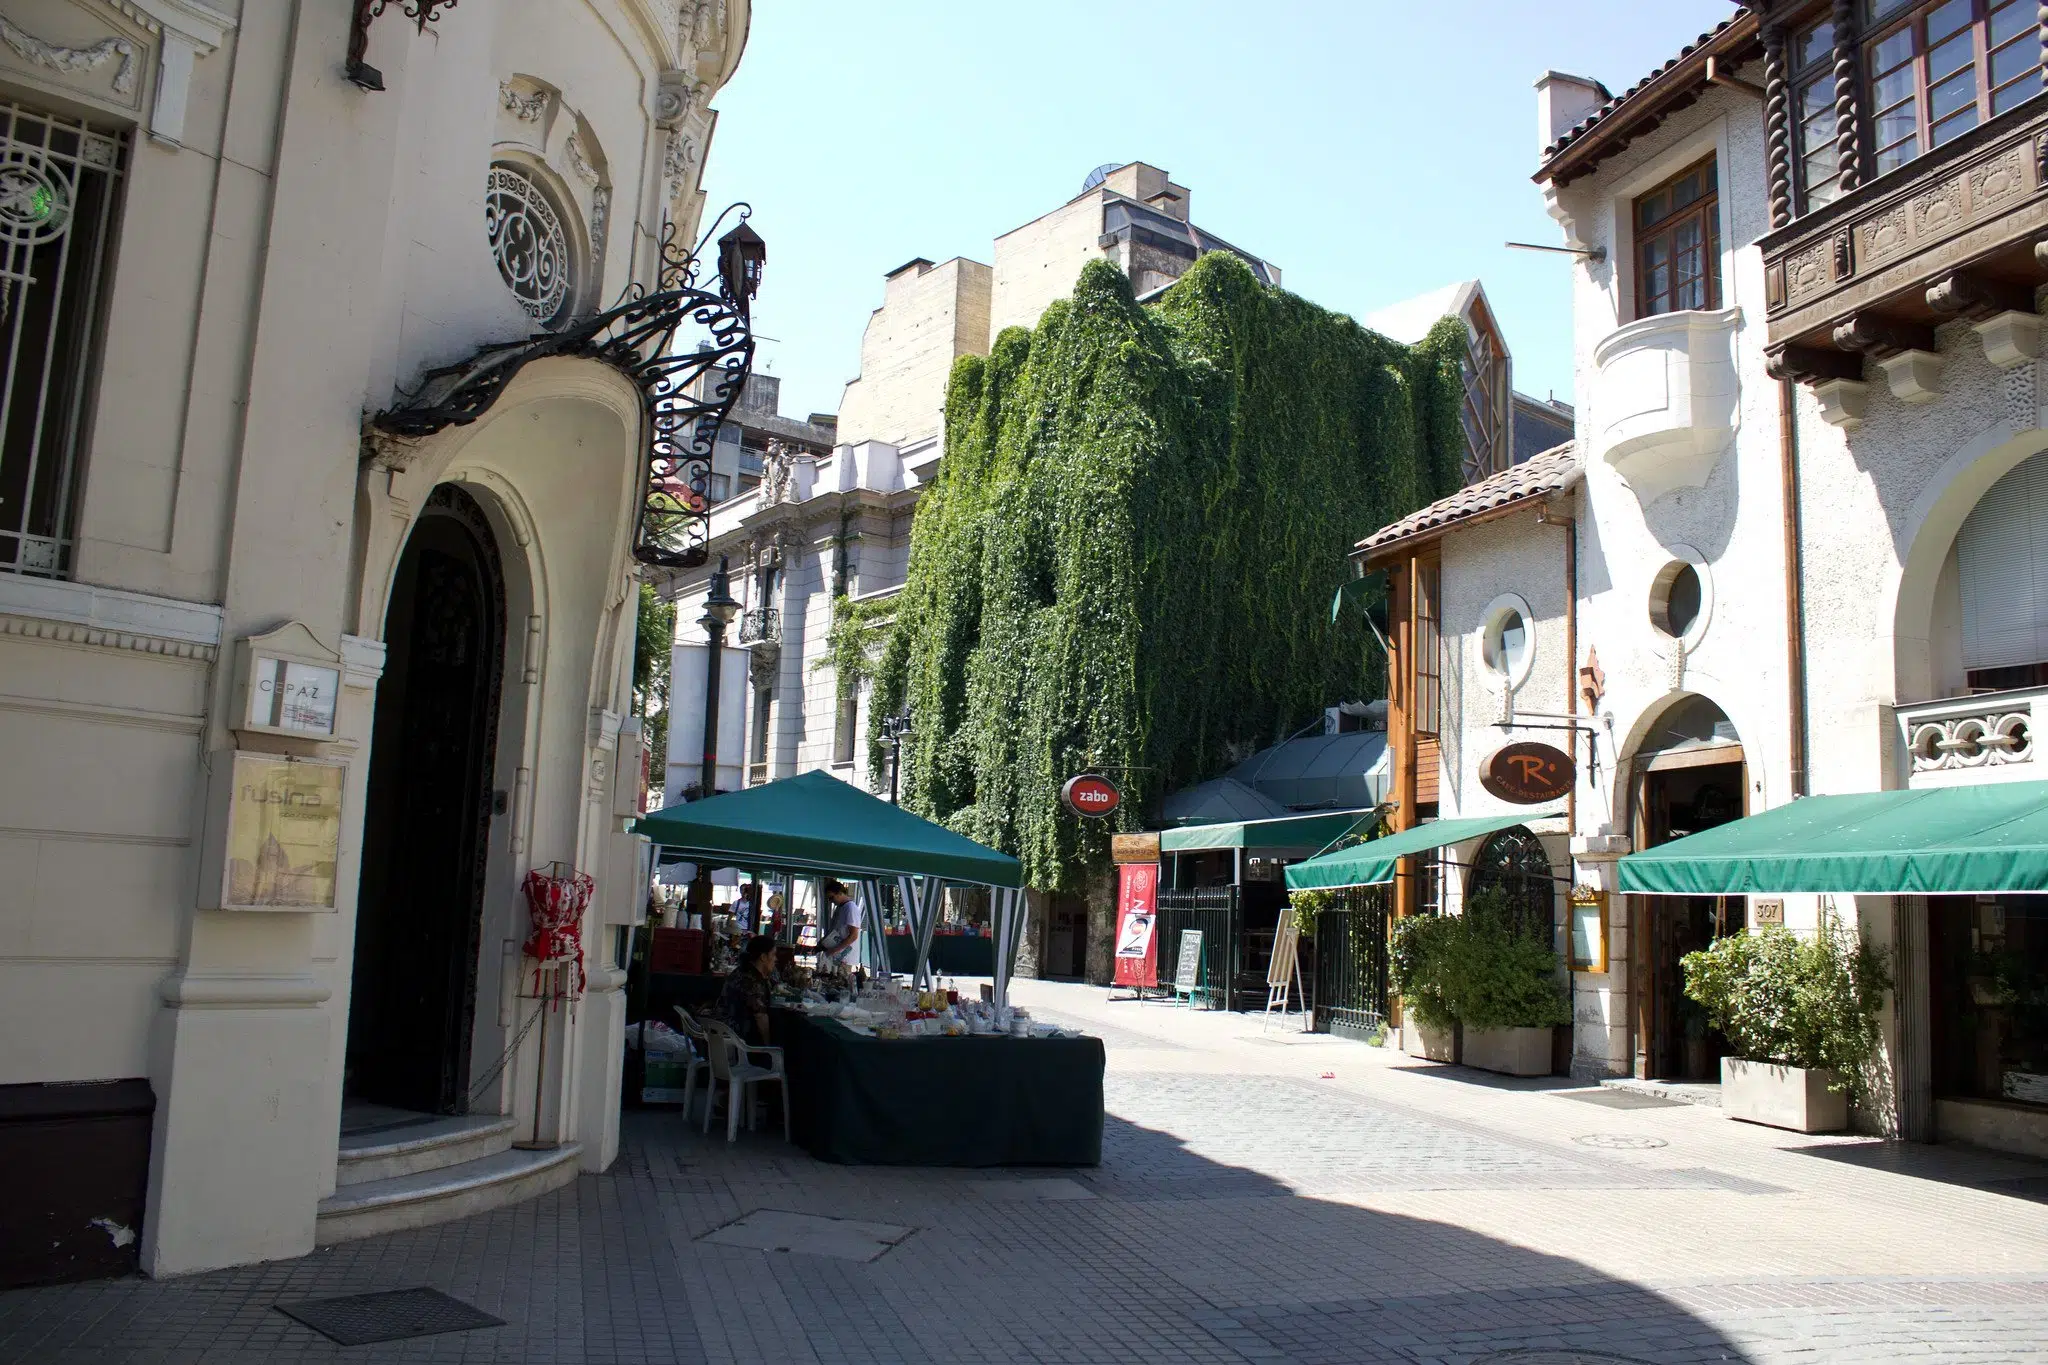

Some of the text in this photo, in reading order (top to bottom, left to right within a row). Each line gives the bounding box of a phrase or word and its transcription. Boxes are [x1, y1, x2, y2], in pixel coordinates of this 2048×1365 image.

[1939, 230, 1990, 263] SEDES
[259, 679, 319, 699] CEPAZ
[1079, 789, 1109, 803] zabo
[1757, 904, 1778, 918] 307
